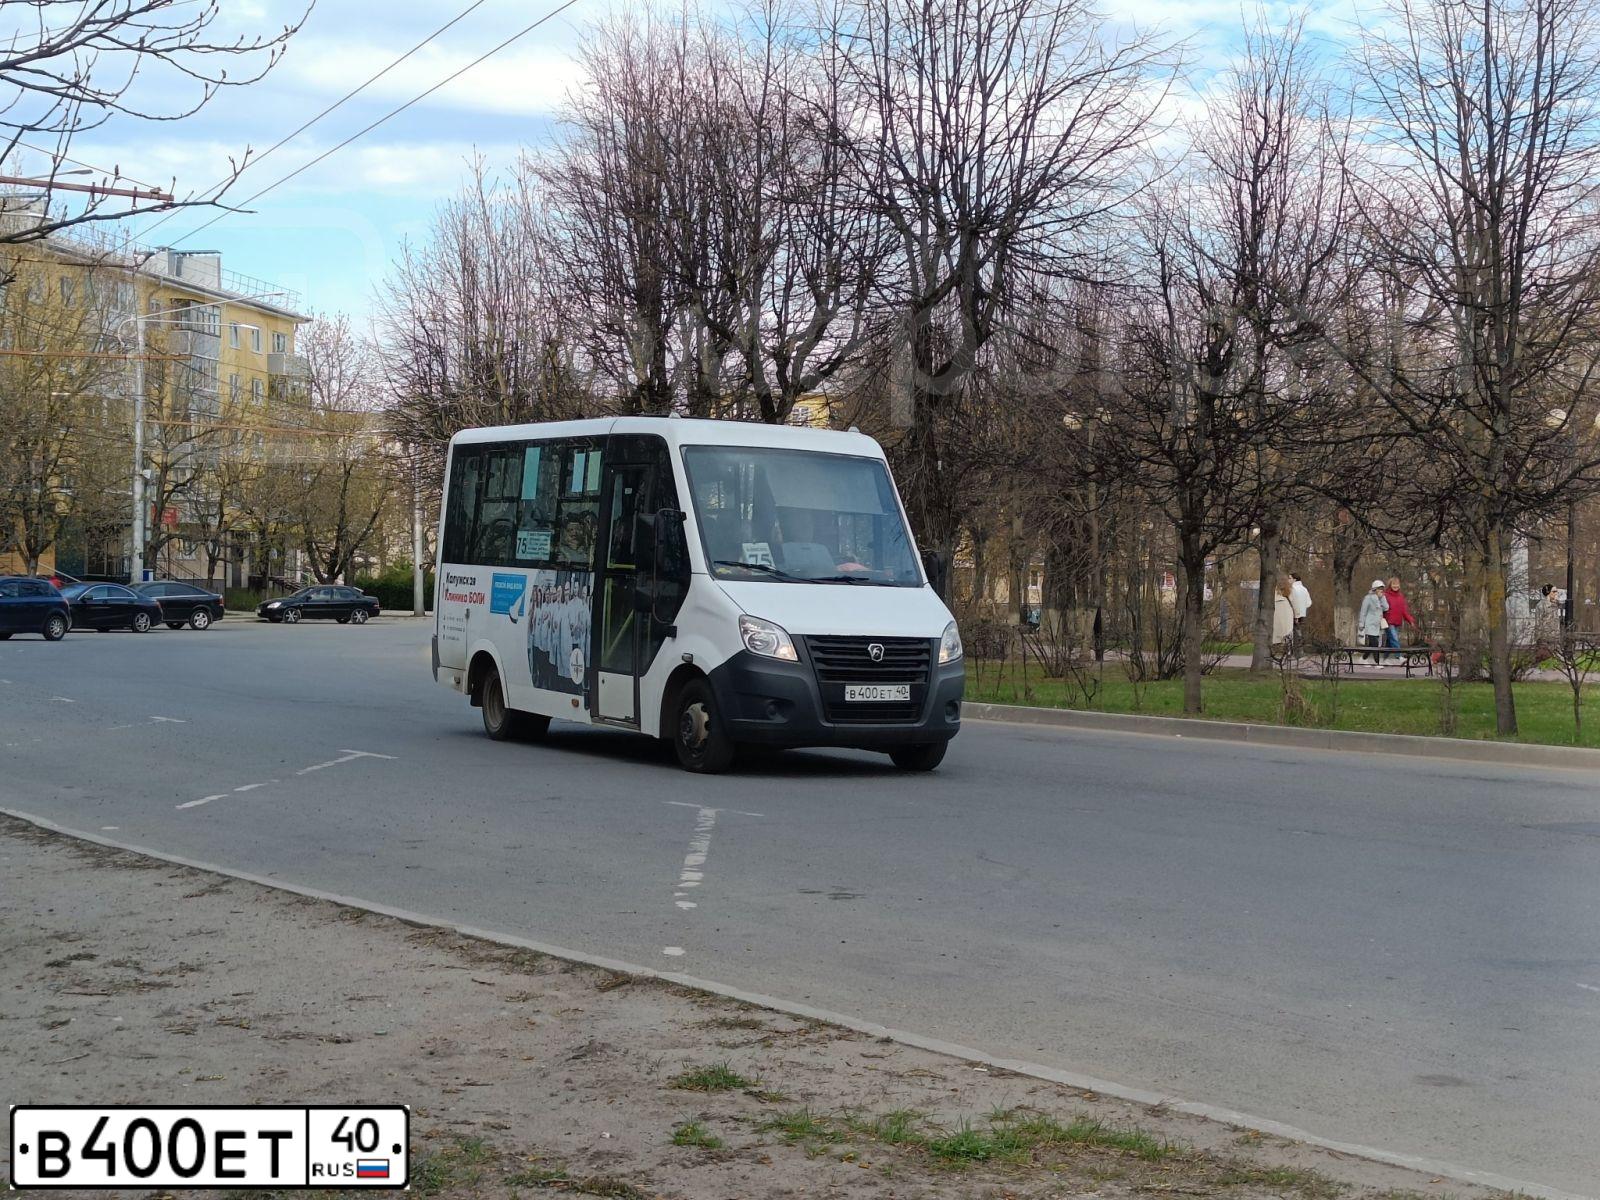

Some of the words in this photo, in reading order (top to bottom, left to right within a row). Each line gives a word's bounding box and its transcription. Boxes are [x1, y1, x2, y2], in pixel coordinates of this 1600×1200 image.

[517, 537, 527, 554] 75
[446, 572, 476, 587] Калужская
[444, 588, 468, 603] Клиника
[469, 592, 485, 605] БОЛИ
[896, 686, 907, 695] 40
